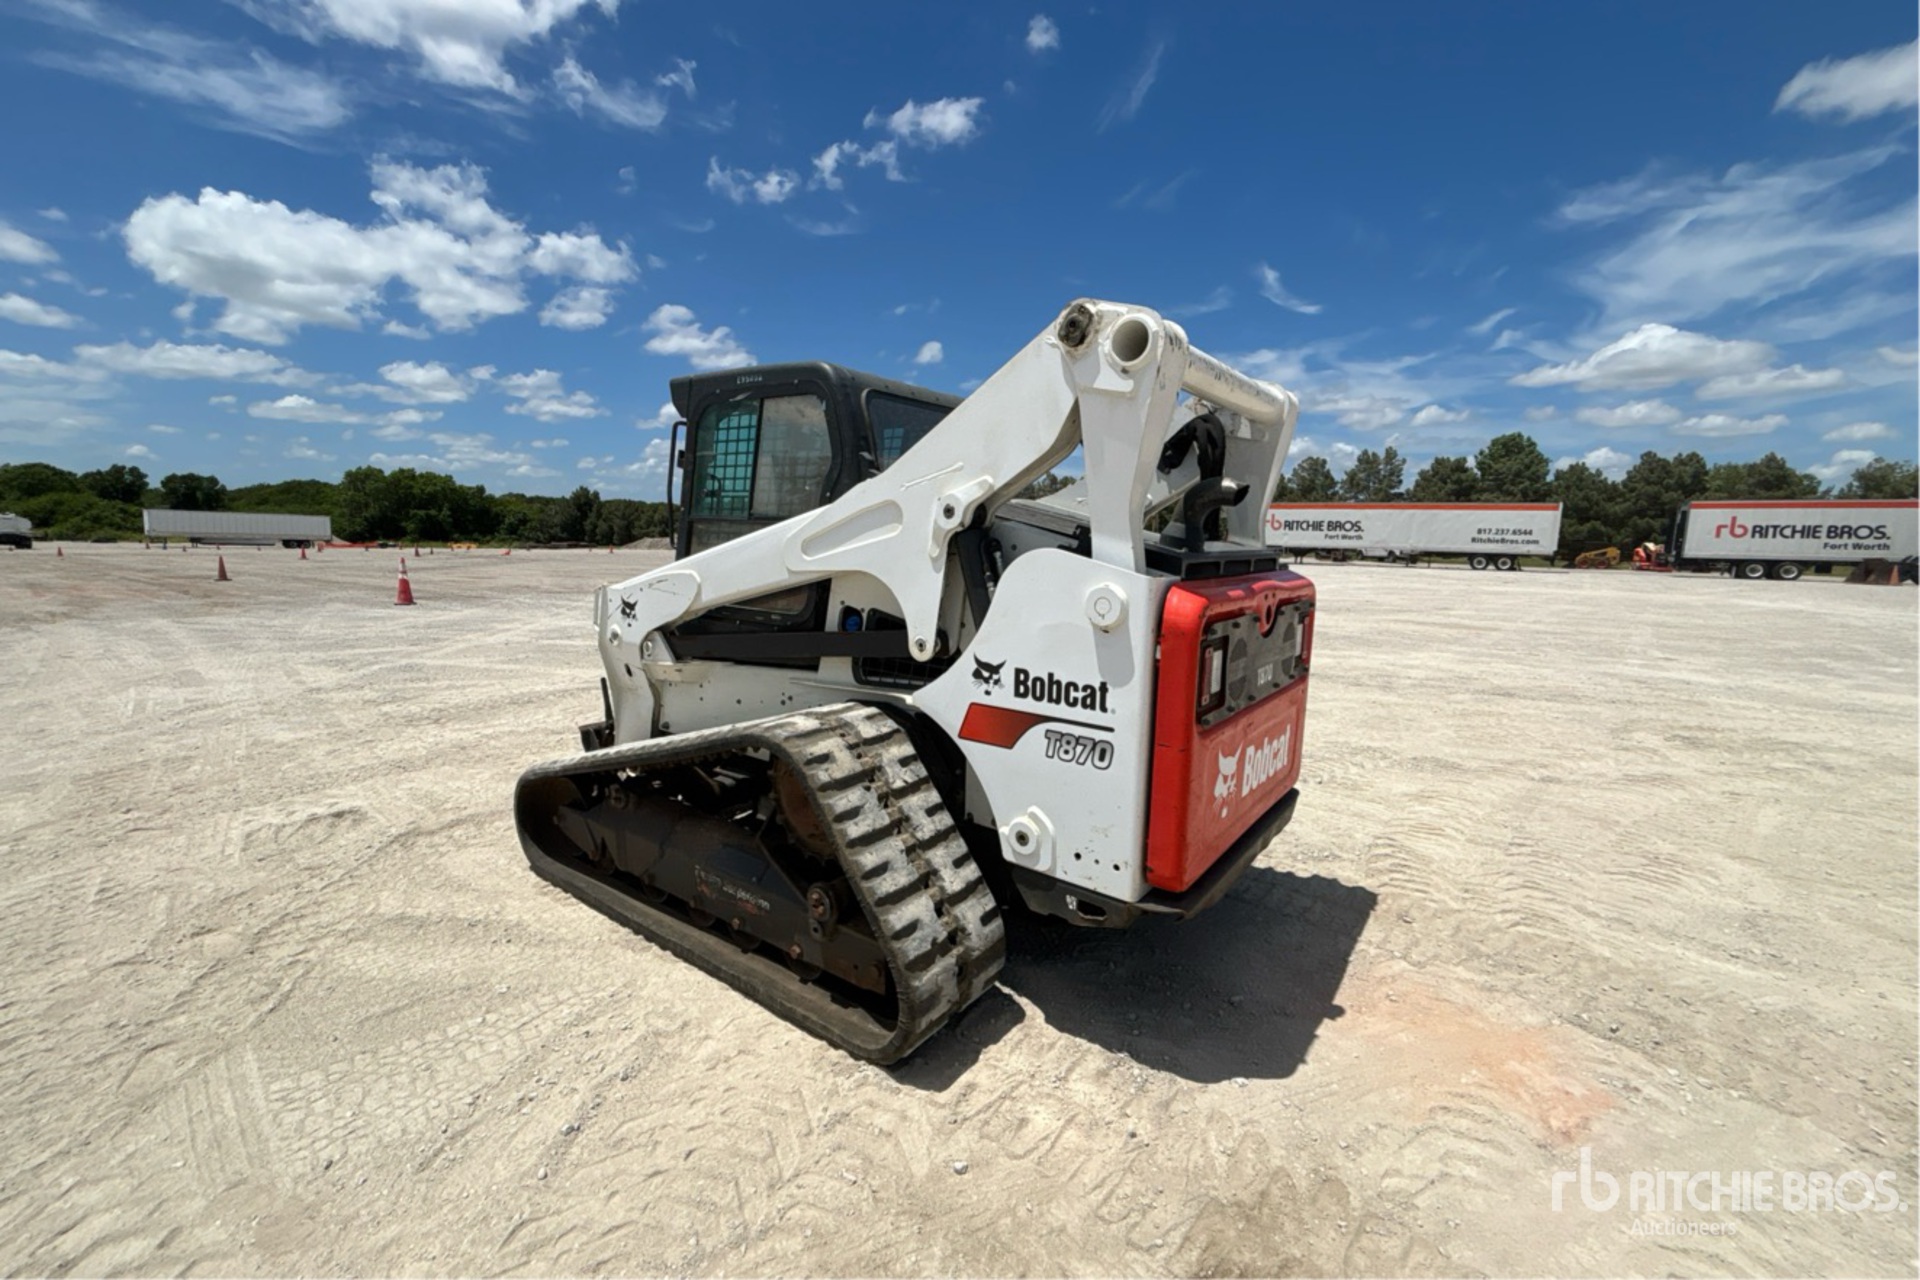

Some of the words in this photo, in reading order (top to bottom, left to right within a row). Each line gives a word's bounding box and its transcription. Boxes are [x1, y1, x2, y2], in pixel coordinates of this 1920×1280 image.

[1265, 513, 1283, 531] b
[1283, 520, 1325, 532] RITCHIE
[1326, 520, 1364, 532] BROS.
[1714, 516, 1749, 539] rb
[1751, 525, 1823, 539] RITCHIE
[1826, 525, 1891, 540] BROS.
[1471, 537, 1540, 545] RitchieBros.com
[1823, 542, 1848, 550] Fort
[1852, 542, 1890, 551] Worth
[1013, 667, 1109, 714] Bobcat
[1044, 729, 1115, 771] T870
[1241, 724, 1292, 798] Bobcat
